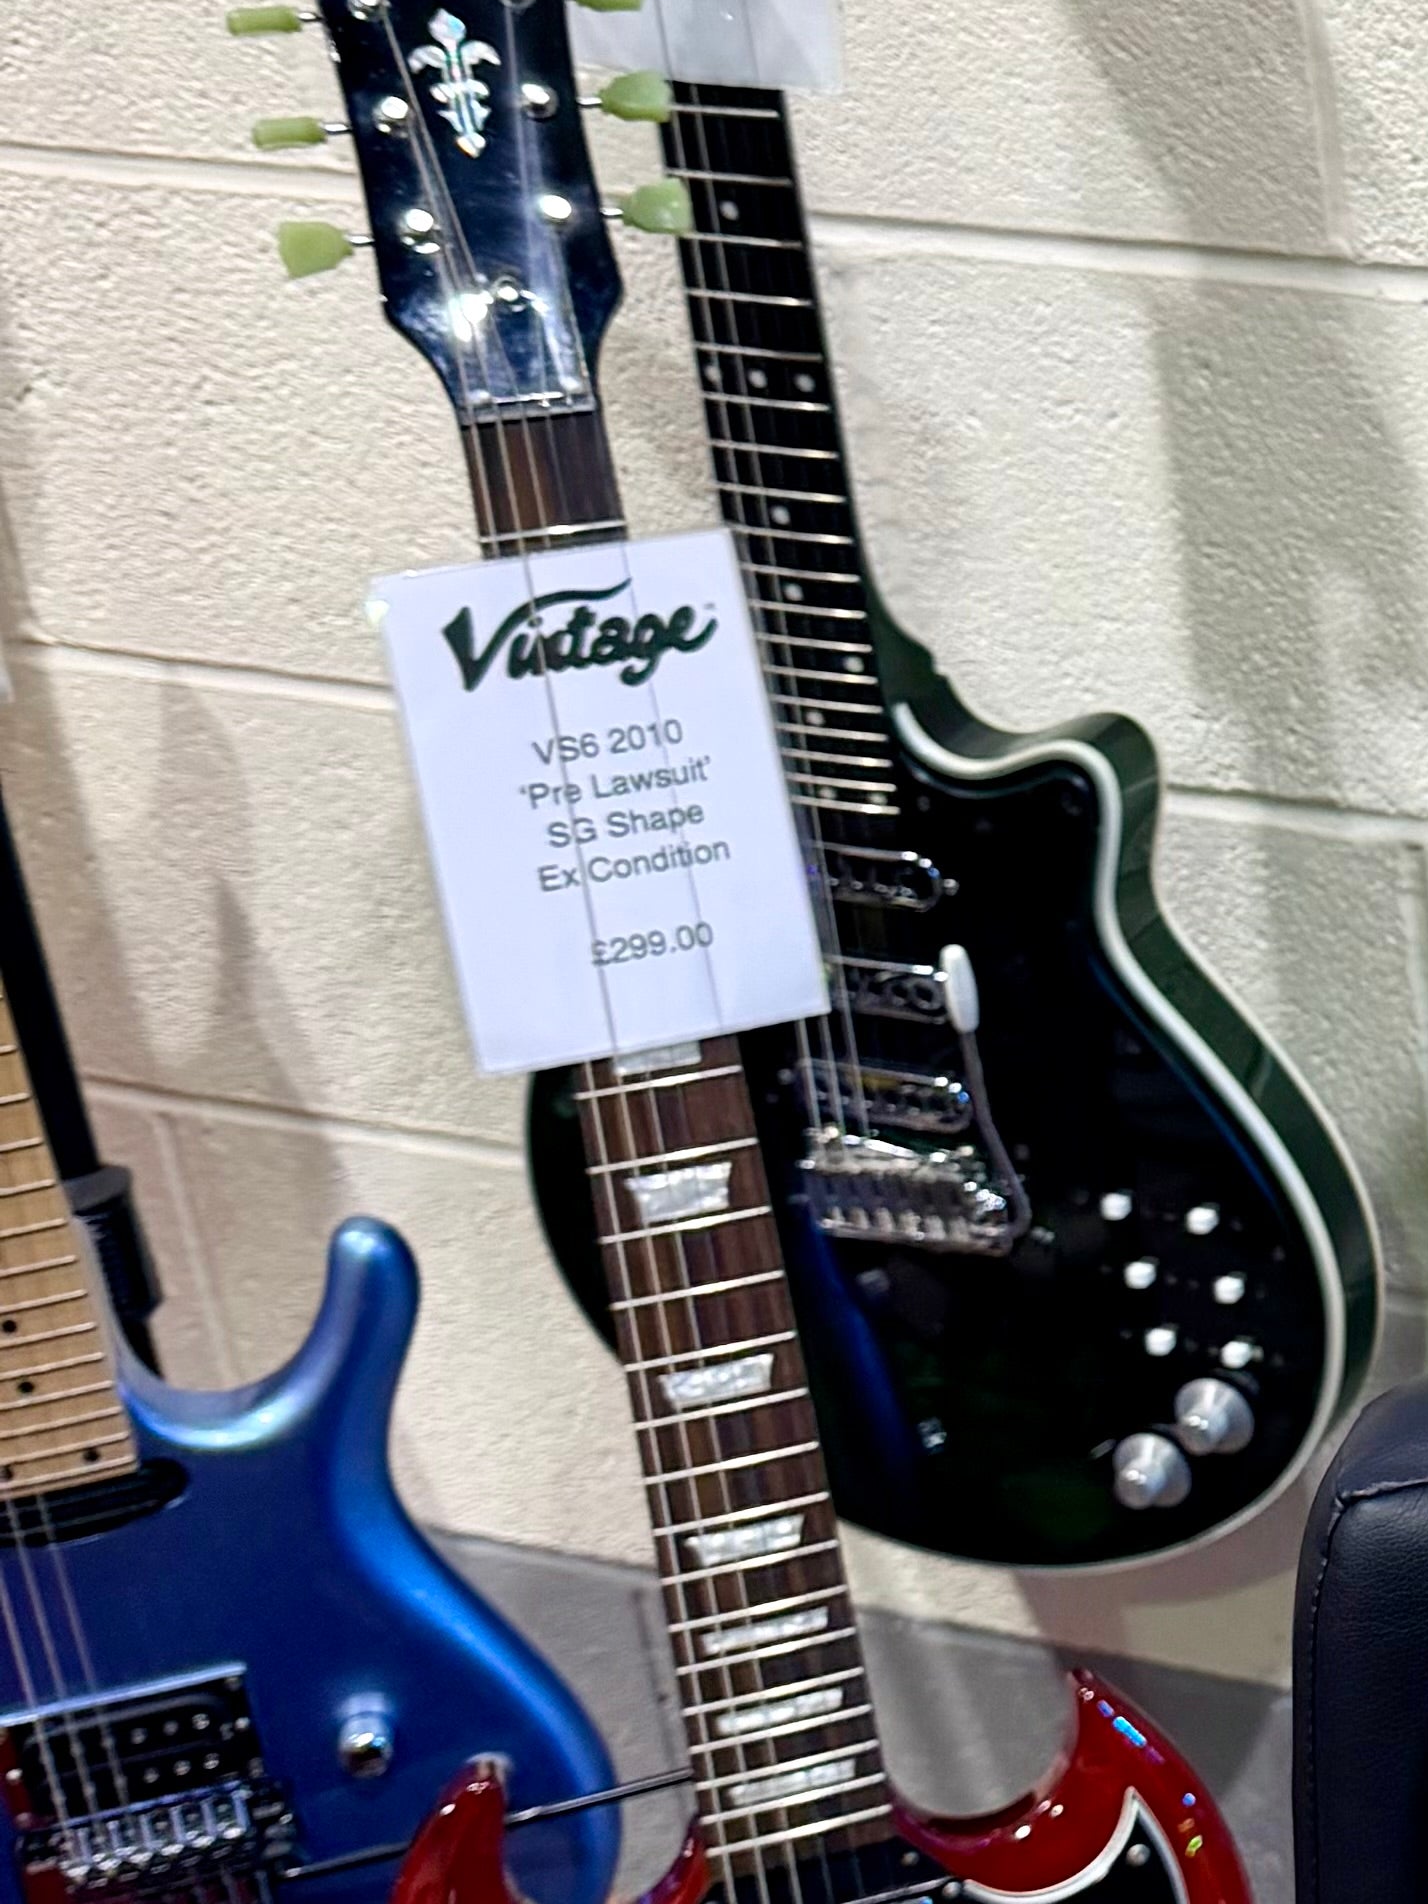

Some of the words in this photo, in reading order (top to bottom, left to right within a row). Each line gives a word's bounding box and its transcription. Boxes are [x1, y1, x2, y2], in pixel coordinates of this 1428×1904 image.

[441, 577, 718, 691] Vintage
[532, 732, 601, 766] VS6
[606, 718, 684, 755] 2010
[547, 816, 599, 849] SG
[606, 802, 706, 841] Shape
[537, 864, 582, 893] Ex
[587, 839, 731, 884] Condition
[590, 920, 715, 968] £299.00
